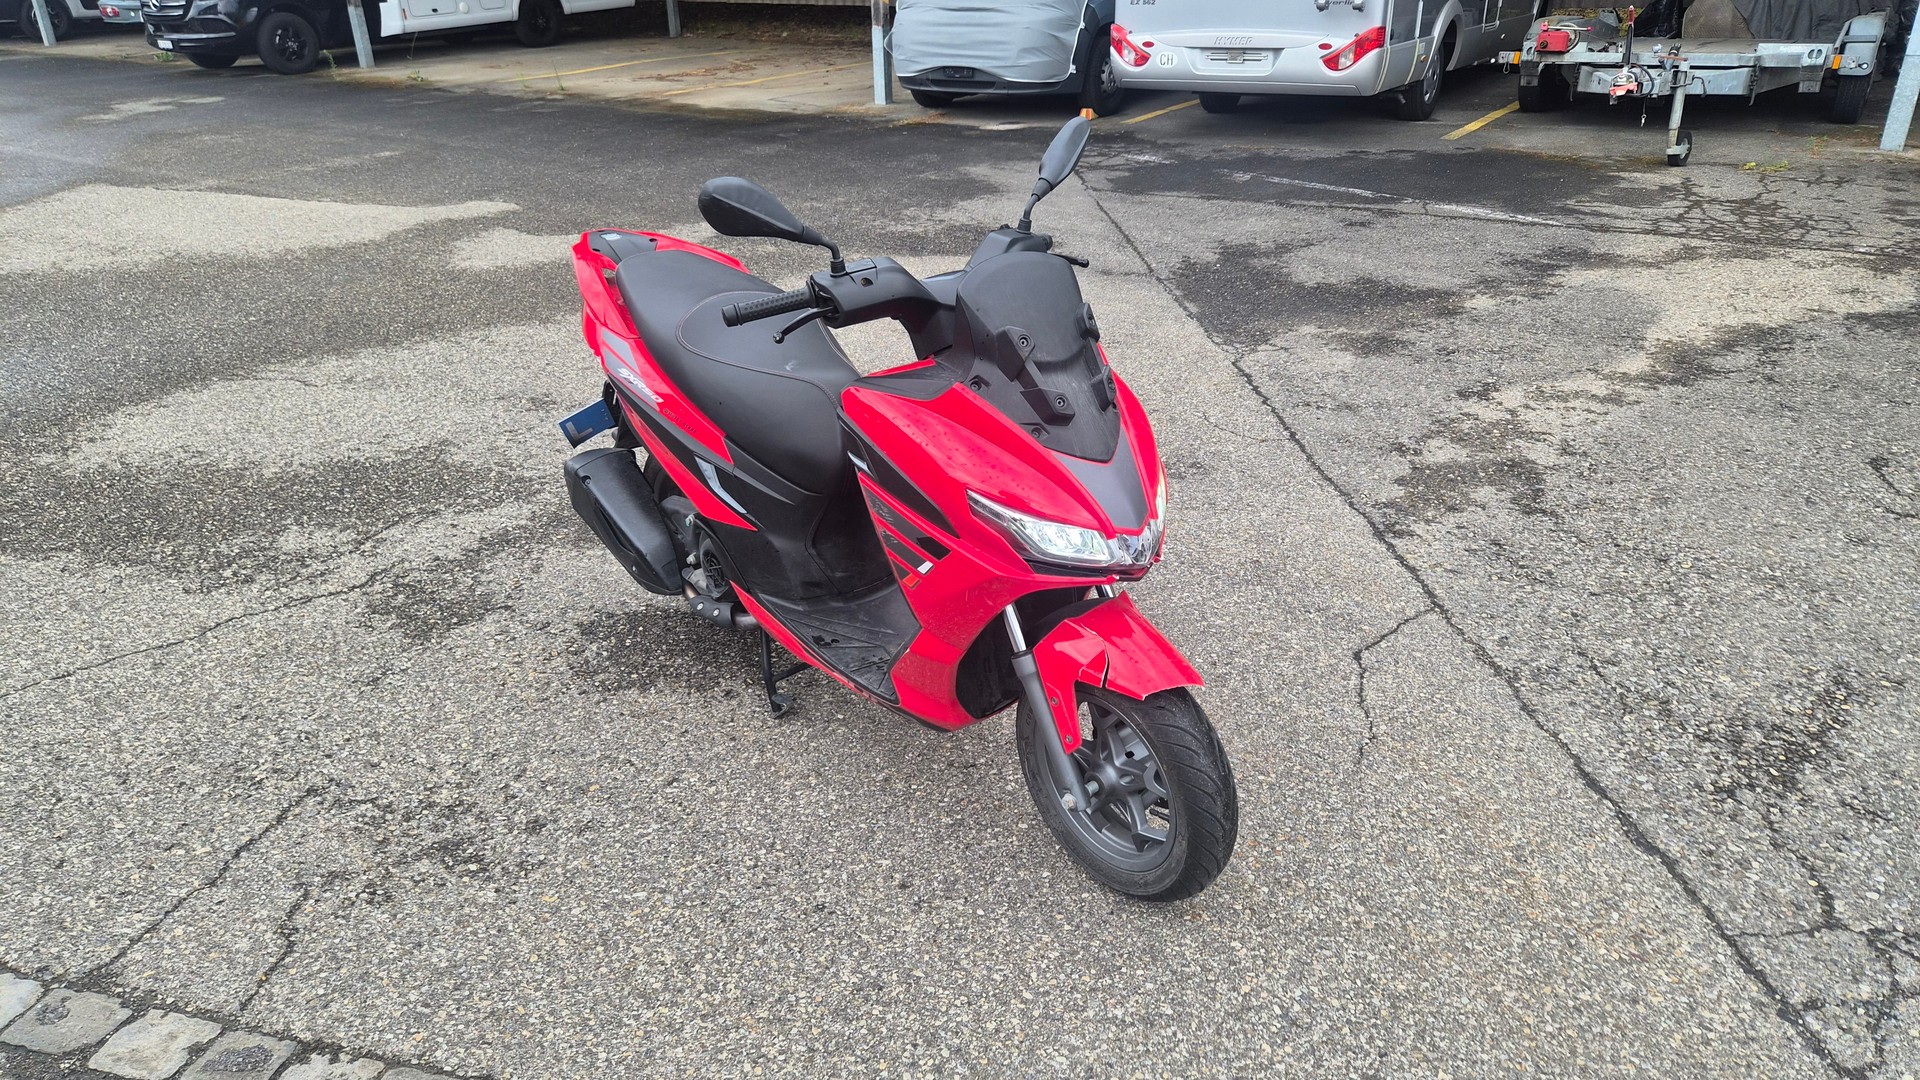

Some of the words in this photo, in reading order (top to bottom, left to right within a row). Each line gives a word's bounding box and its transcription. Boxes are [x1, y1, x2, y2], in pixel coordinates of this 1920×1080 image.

[1160, 54, 1174, 66] CH
[617, 368, 665, 403] SXR50
[565, 421, 593, 442] L
